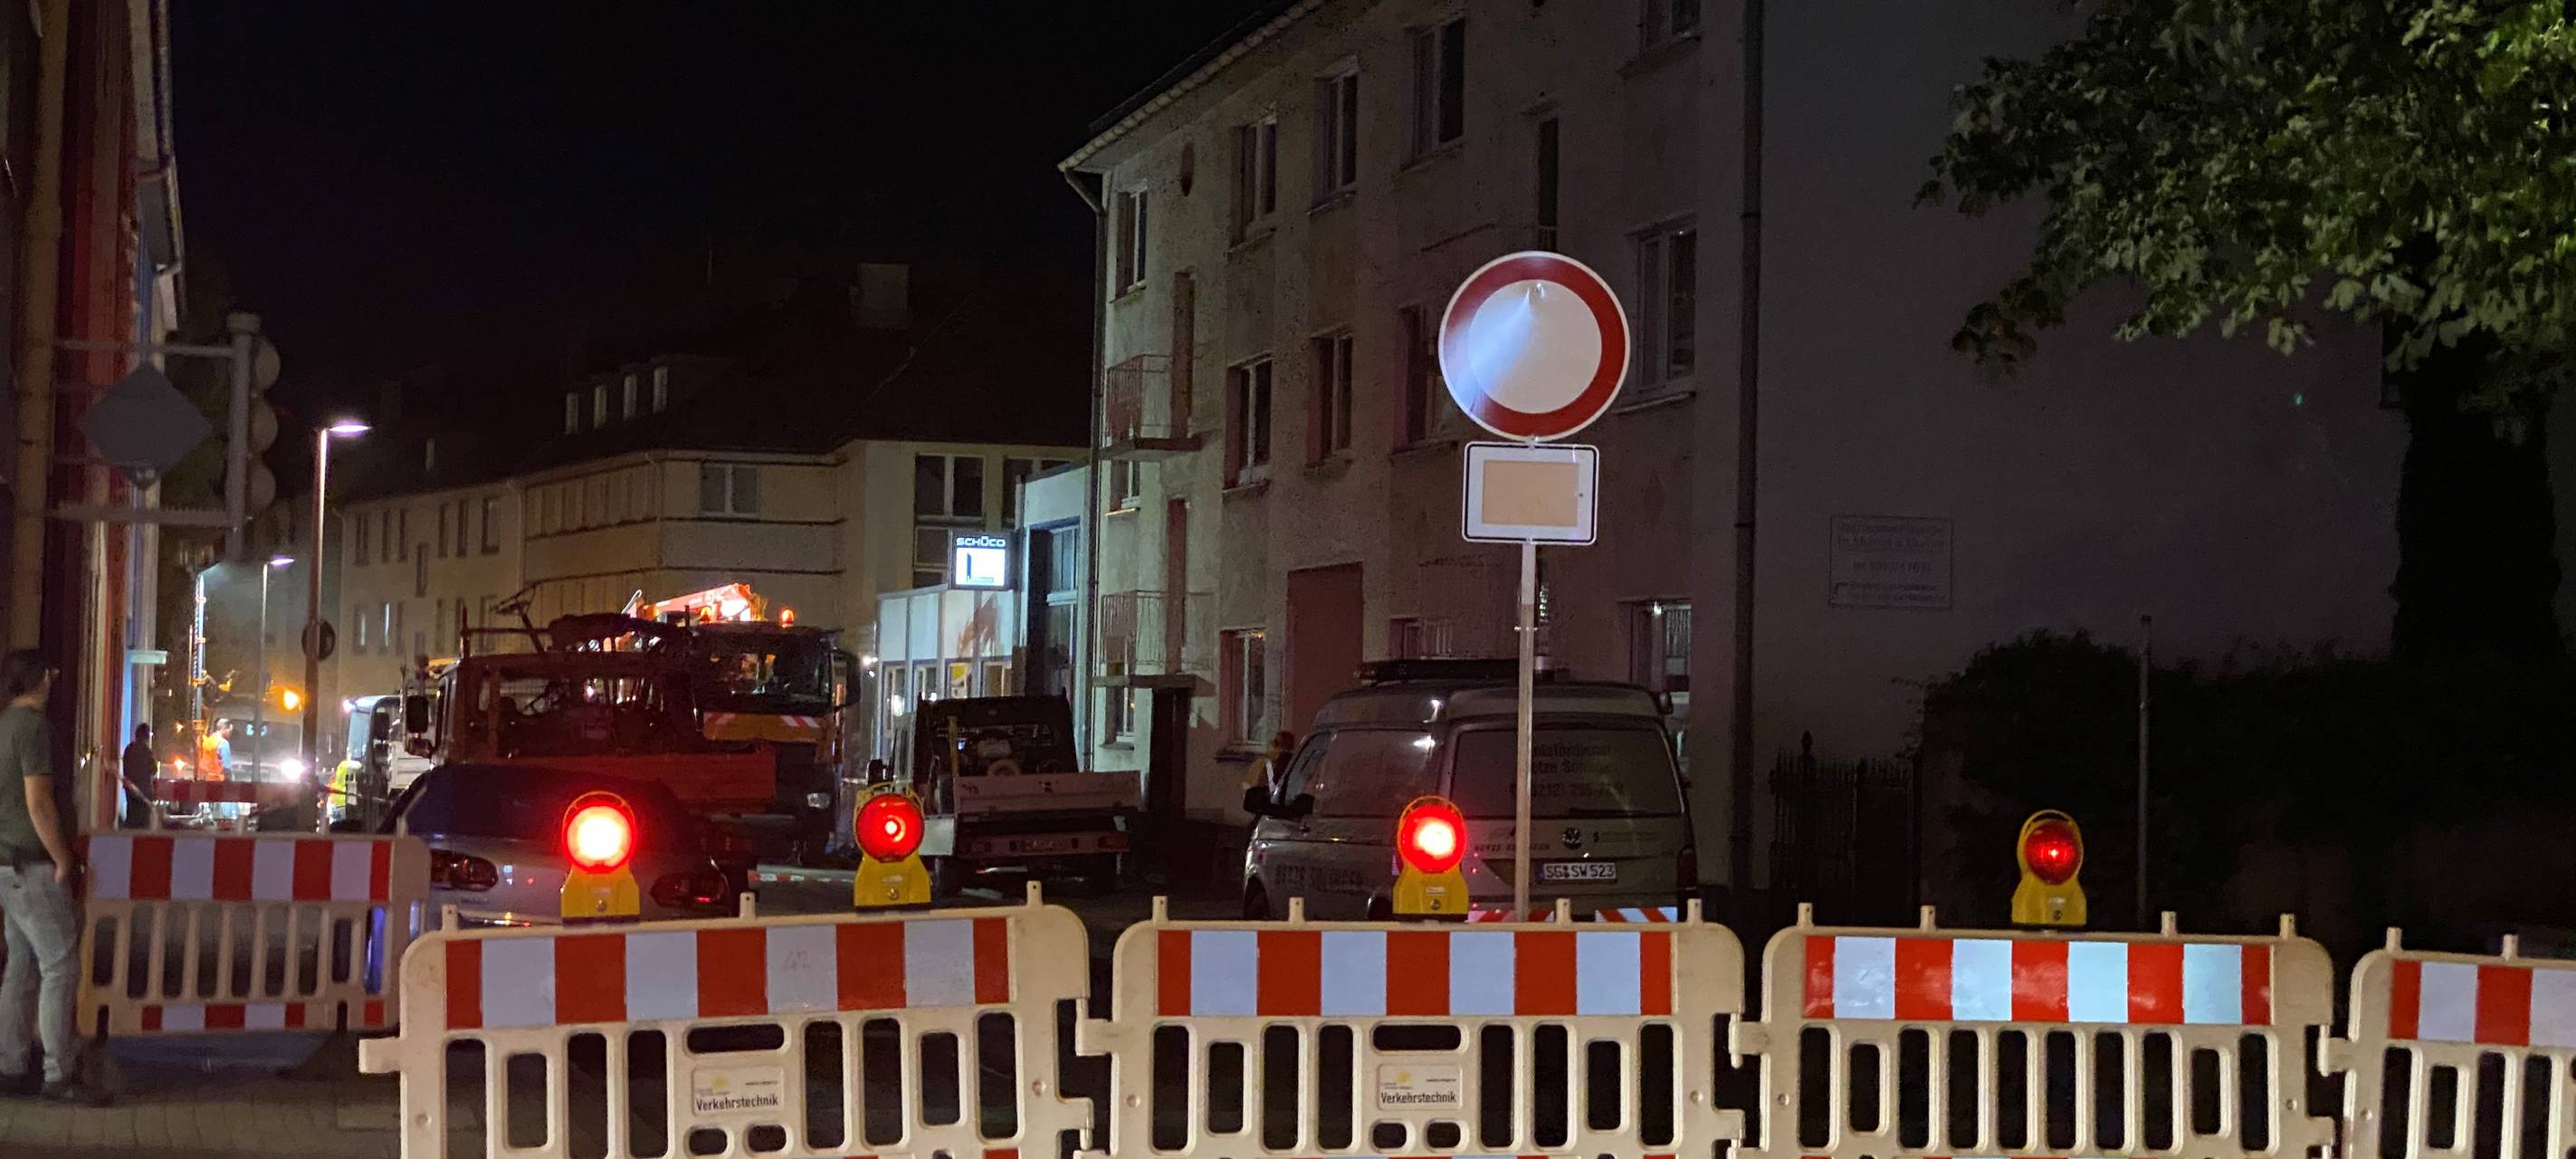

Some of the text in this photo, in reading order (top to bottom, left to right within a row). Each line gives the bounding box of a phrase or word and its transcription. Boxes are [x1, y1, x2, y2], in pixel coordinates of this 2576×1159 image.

[956, 536, 1007, 548] SCHÜCO
[1546, 864, 1615, 878] SG SW 523
[696, 1094, 778, 1111] Verkehrstechnik
[1381, 1091, 1456, 1103] Verkehrstechnik
